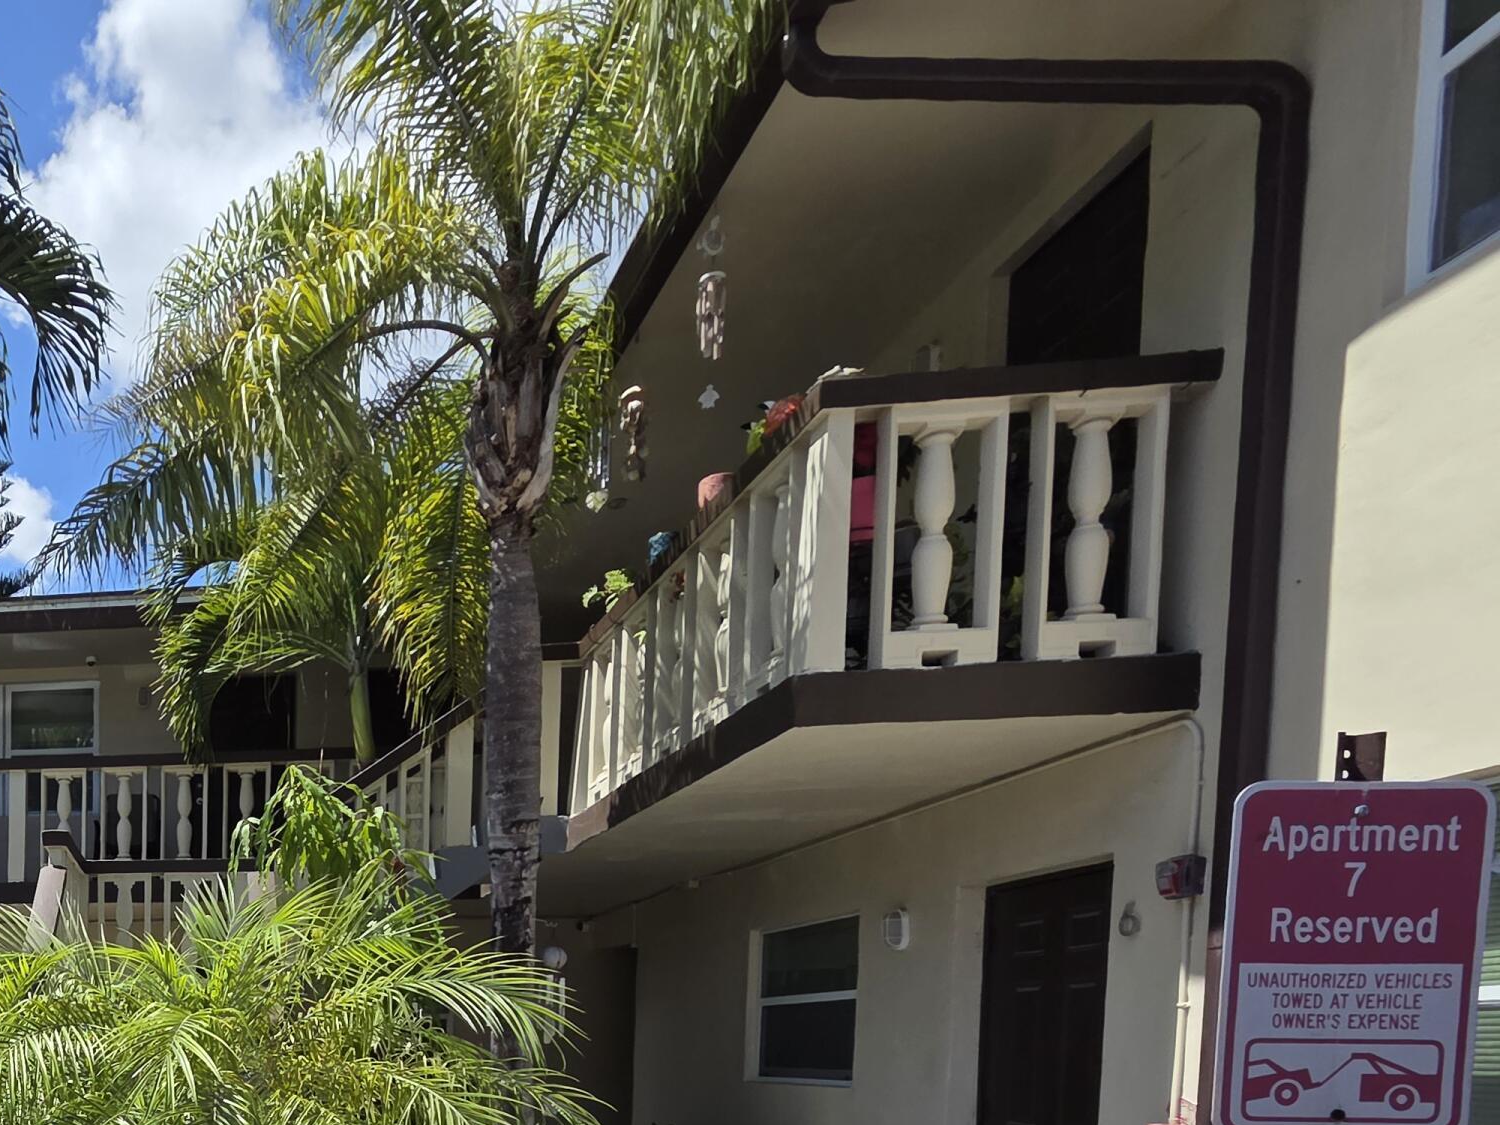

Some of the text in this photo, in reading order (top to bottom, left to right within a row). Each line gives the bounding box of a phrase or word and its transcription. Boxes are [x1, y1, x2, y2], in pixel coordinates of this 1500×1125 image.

[1262, 816, 1462, 861] Apartment
[1344, 862, 1367, 898] 7
[1118, 899, 1141, 937] 6
[1270, 907, 1439, 944] Reserved
[1247, 972, 1453, 989] UNAUTHORIZED VEHICLES
[1271, 993, 1423, 1010] TOWED AT VEHICLE
[1271, 1013, 1420, 1031] OWNER'S EXPENSE
